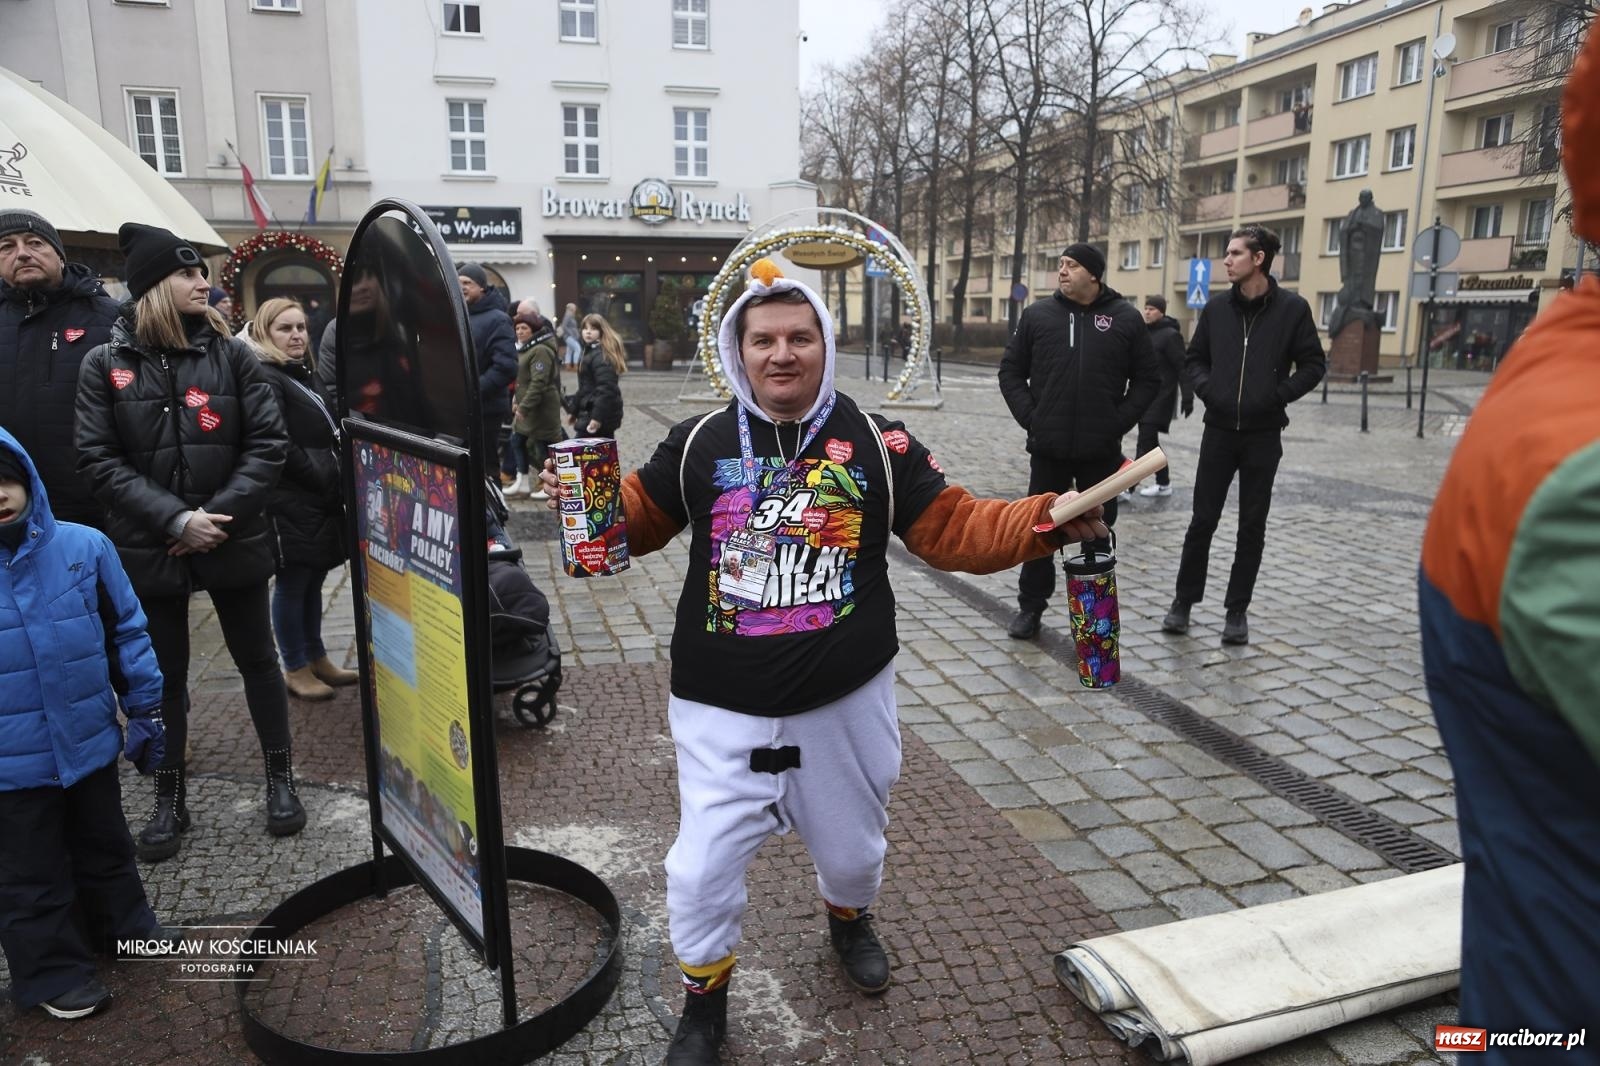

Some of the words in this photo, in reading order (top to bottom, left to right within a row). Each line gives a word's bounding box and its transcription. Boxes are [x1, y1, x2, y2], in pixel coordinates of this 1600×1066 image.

[0, 185, 33, 197] ICE
[541, 186, 625, 218] Browar
[680, 190, 751, 224] Rynek
[454, 219, 516, 239] Wypieki
[411, 502, 423, 534] A
[426, 507, 455, 551] MY,
[750, 490, 816, 532] 34
